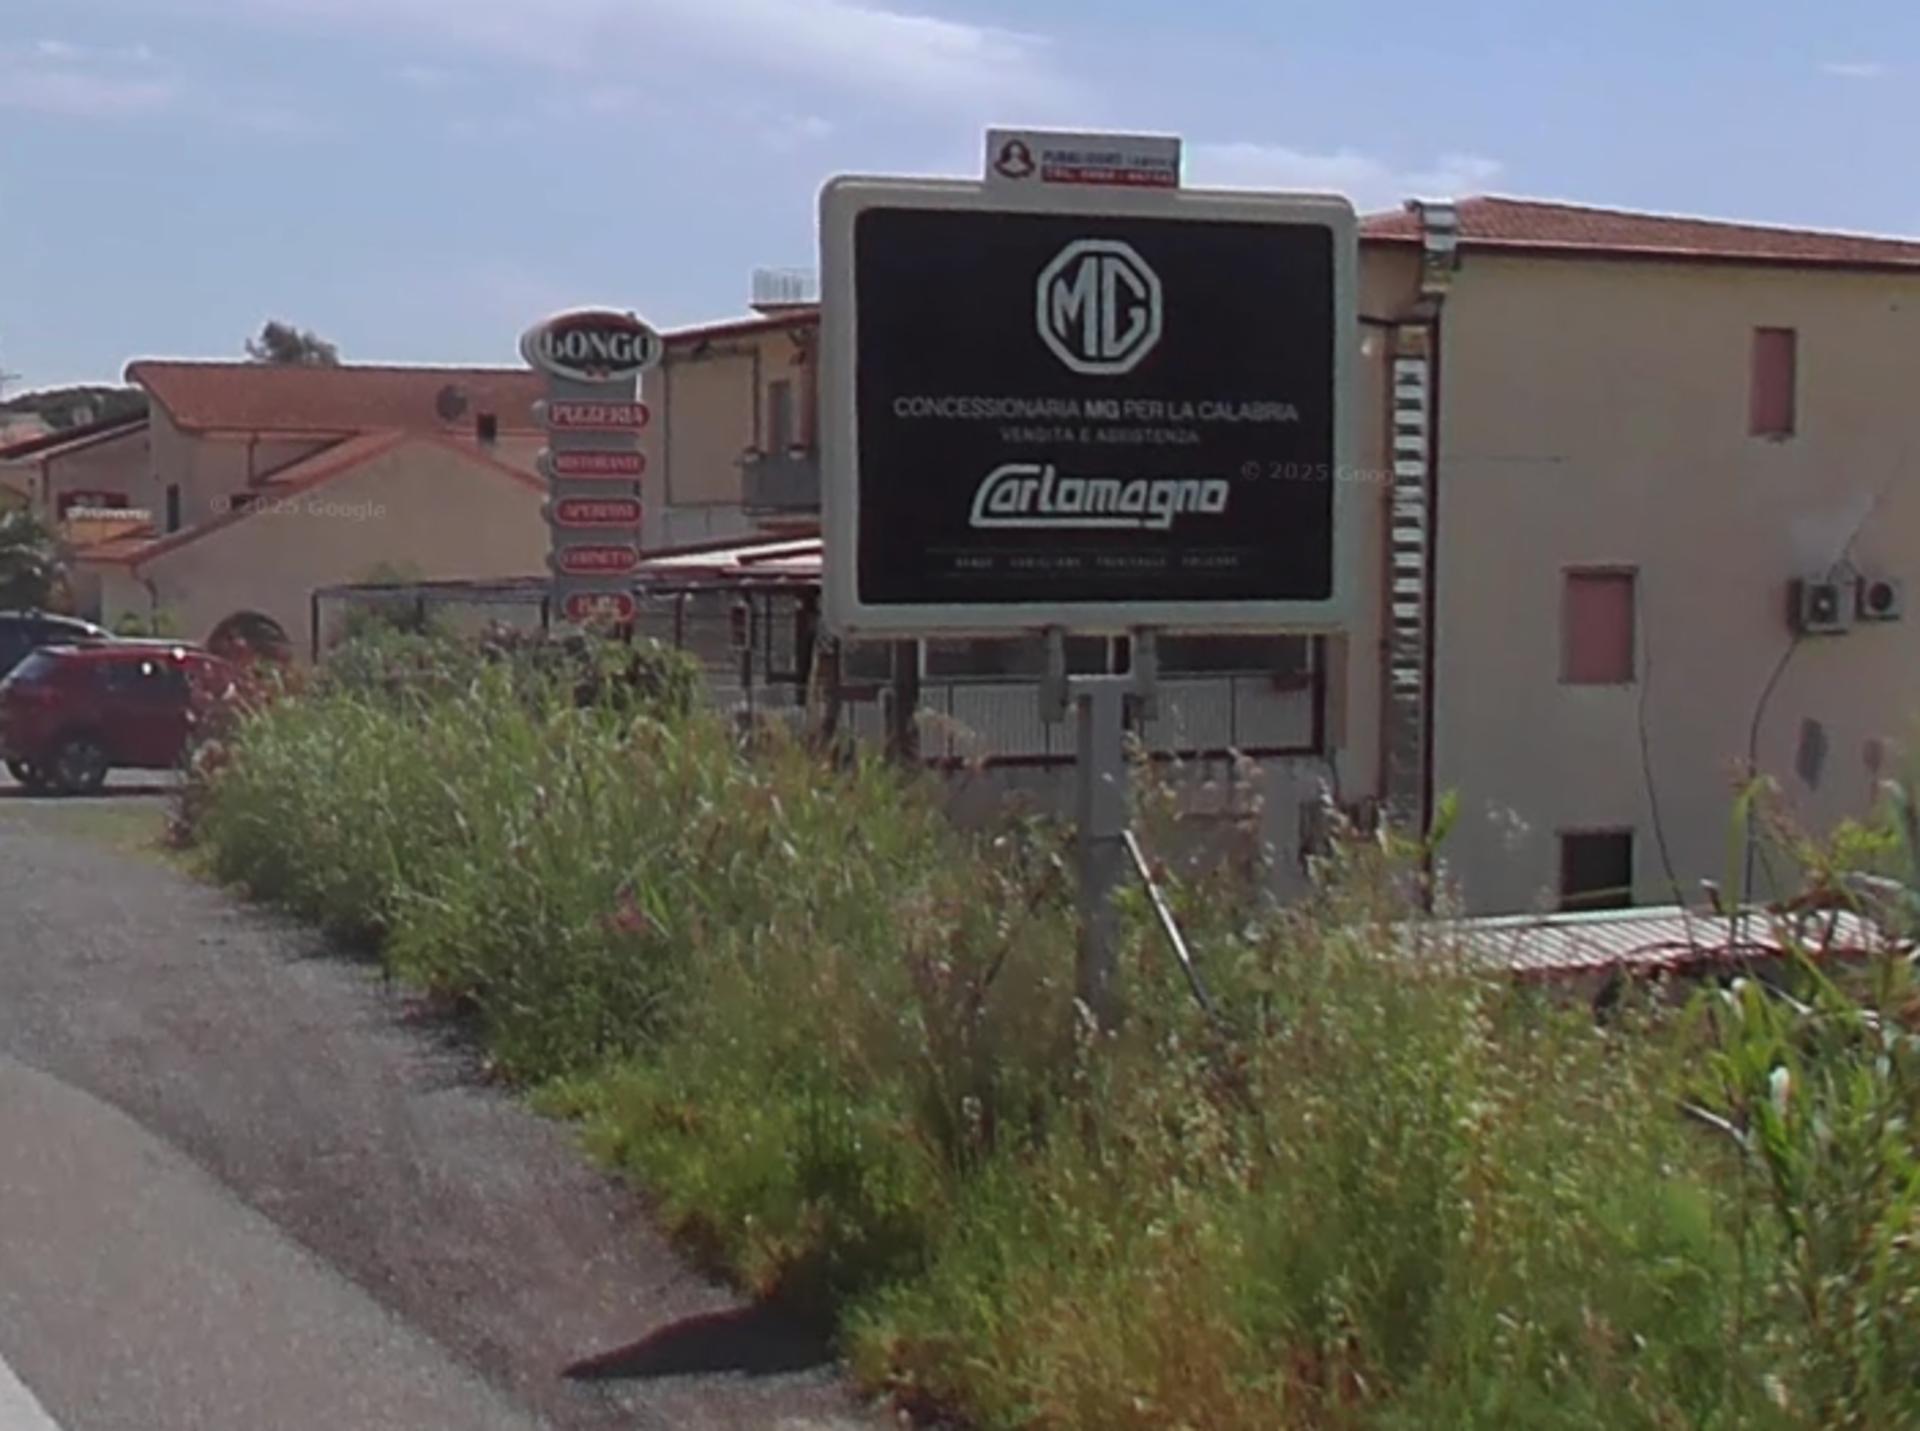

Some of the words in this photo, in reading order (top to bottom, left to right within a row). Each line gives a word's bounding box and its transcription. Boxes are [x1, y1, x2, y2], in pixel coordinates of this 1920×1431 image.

[1052, 256, 1146, 357] MG
[541, 330, 654, 361] LONGO
[552, 405, 643, 424] PIZZERIA
[894, 396, 1080, 418] CONCESSIONARIA
[1084, 398, 1121, 420] MG
[1123, 399, 1163, 420] PER
[1168, 400, 1195, 420] LA
[1198, 400, 1299, 423] CALABRIA
[969, 463, 1230, 529] Carlomagno
